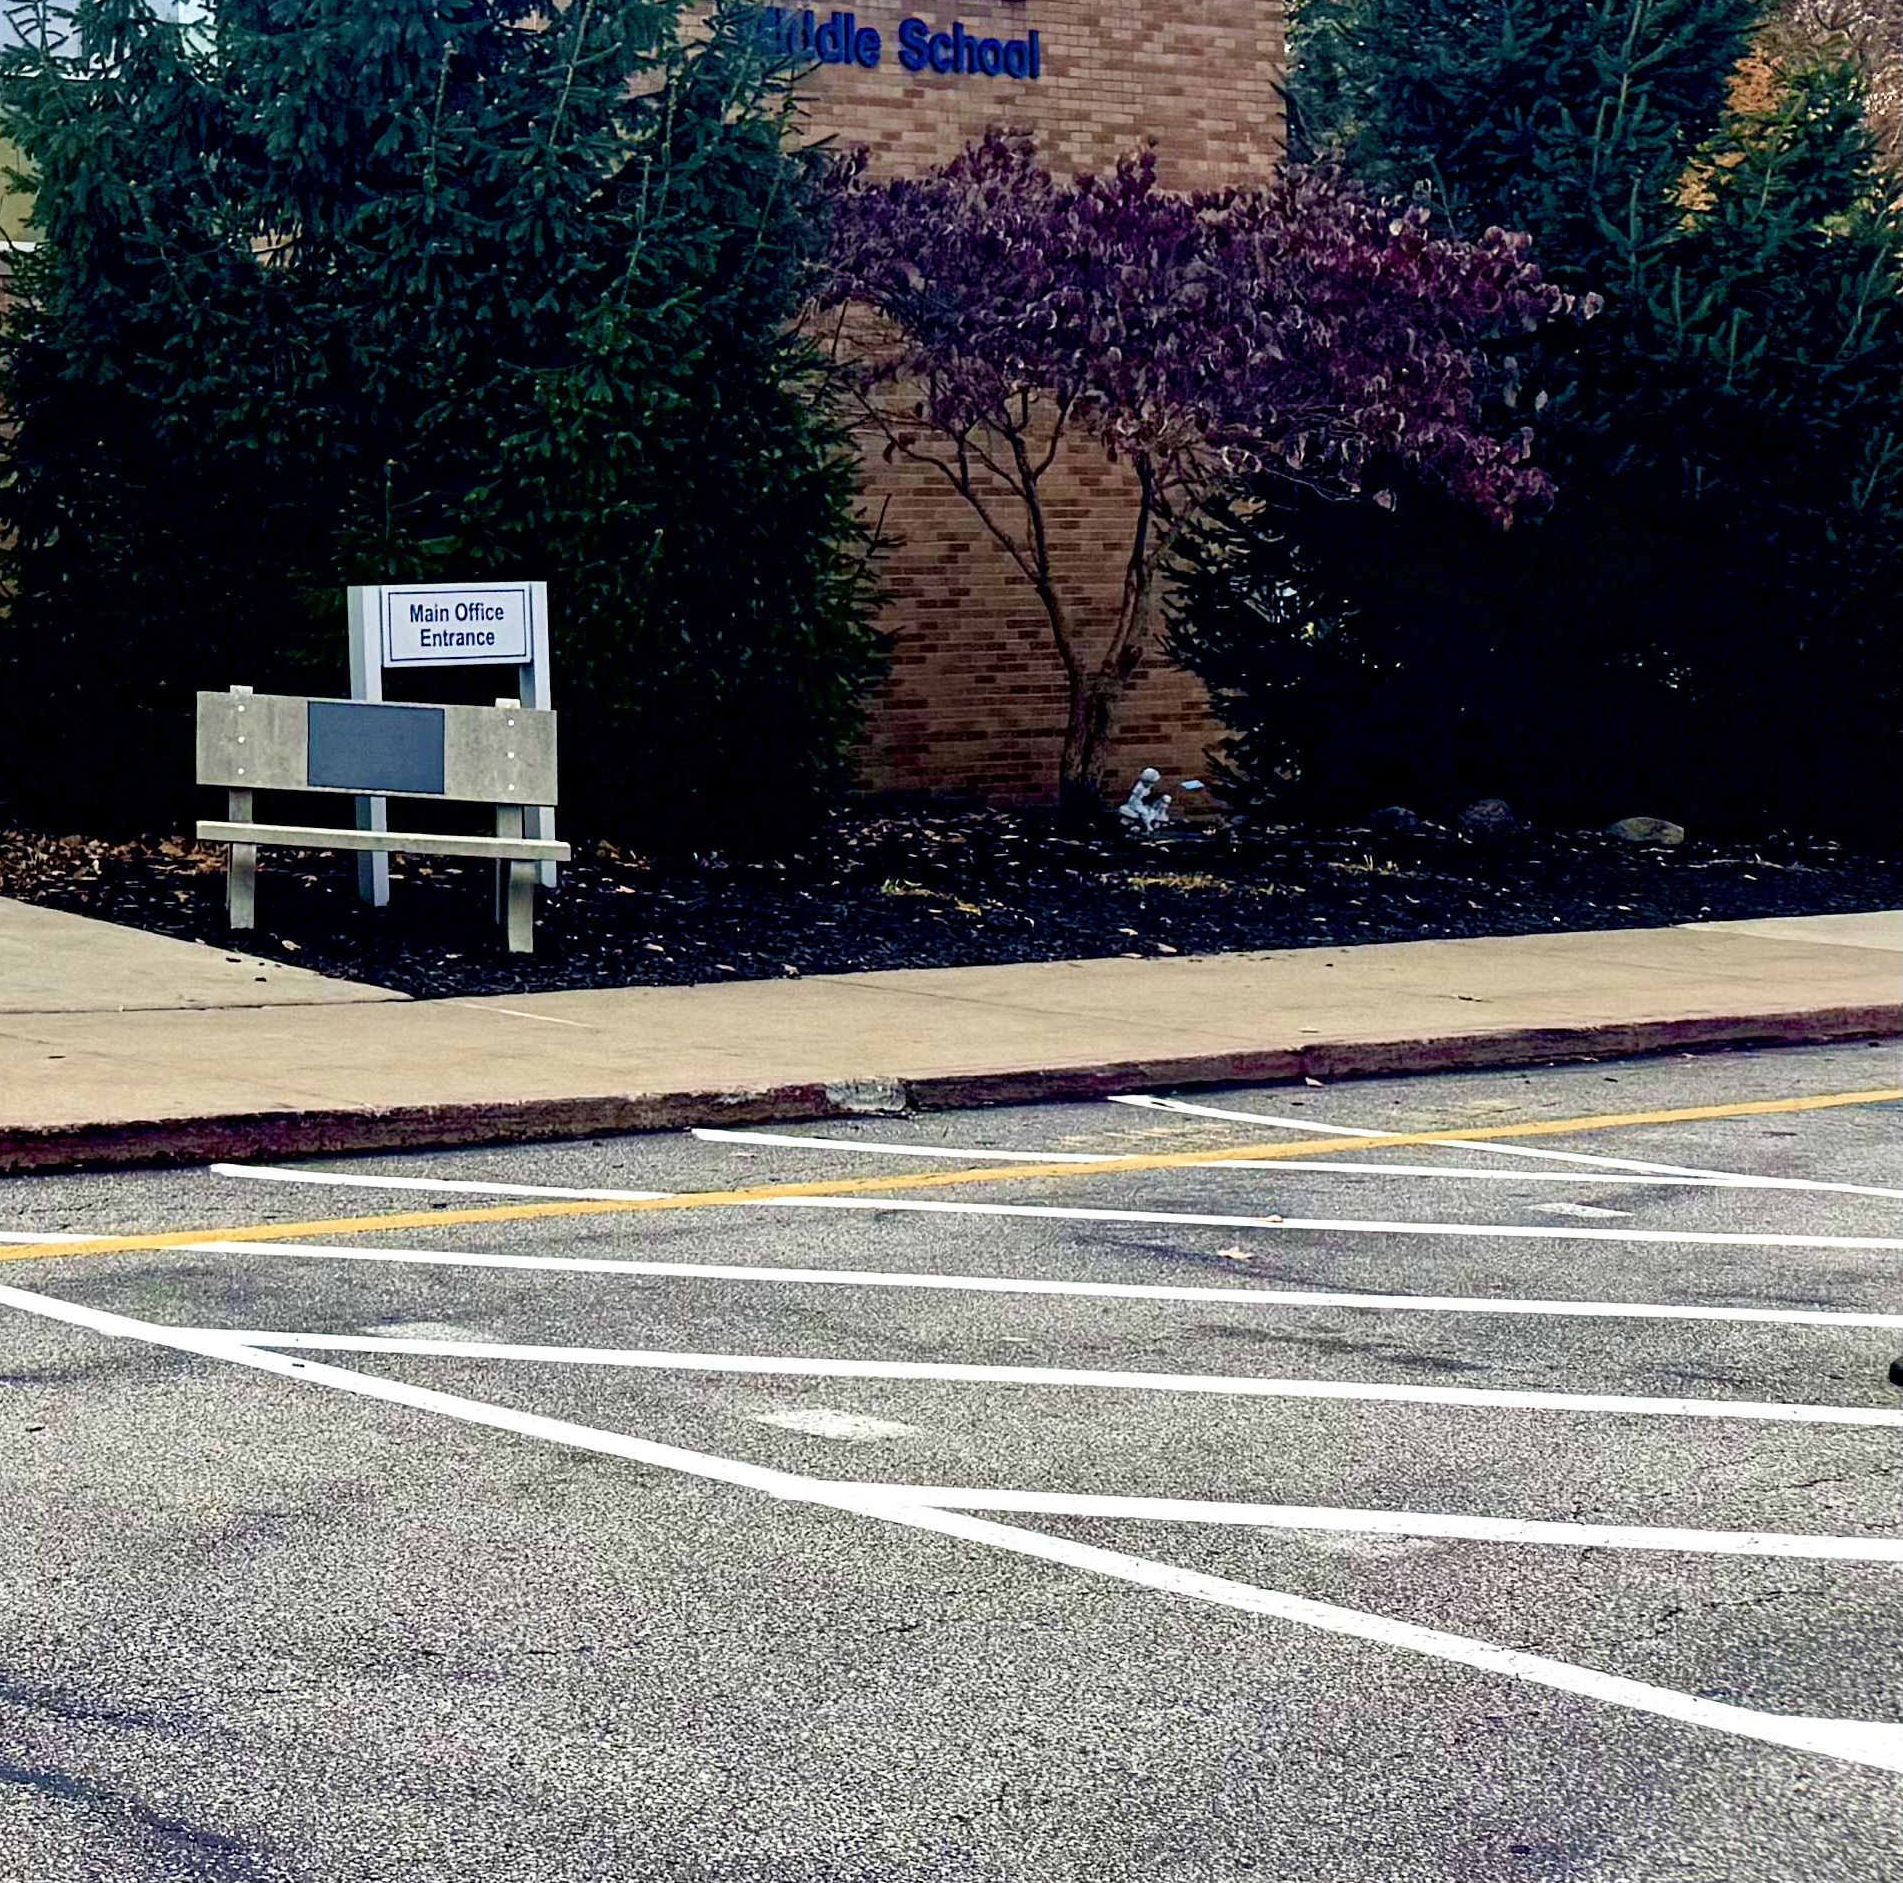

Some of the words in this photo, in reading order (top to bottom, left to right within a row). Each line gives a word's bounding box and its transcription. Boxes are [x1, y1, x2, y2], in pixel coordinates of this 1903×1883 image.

[898, 17, 1040, 79] School
[410, 603, 449, 622] Main
[455, 602, 504, 621] Office
[420, 628, 495, 647] Entrance
